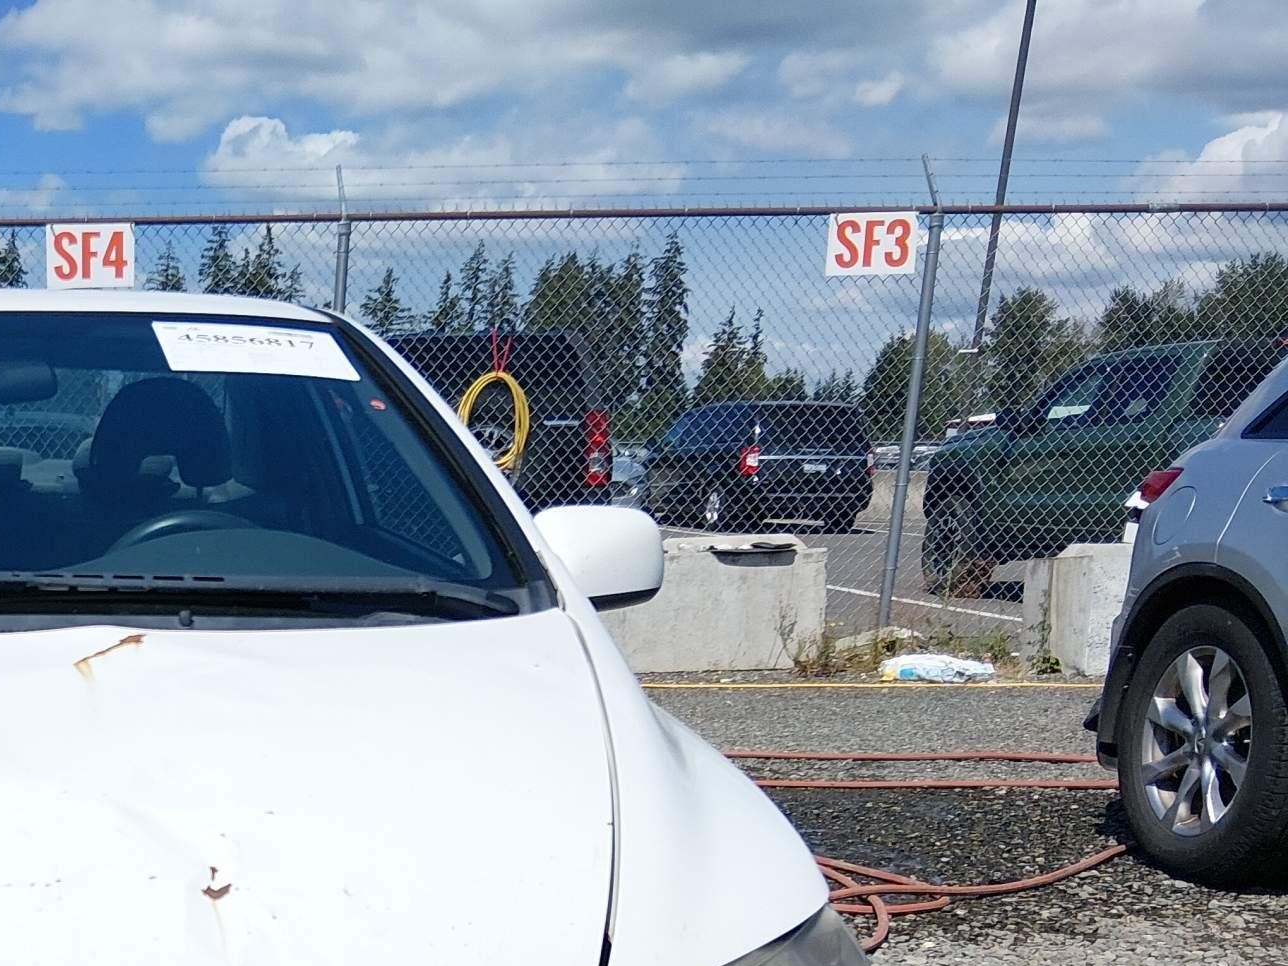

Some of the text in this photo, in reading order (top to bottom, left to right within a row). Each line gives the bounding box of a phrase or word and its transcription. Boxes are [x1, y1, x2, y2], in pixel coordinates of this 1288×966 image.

[53, 231, 128, 280] SF4
[834, 218, 911, 268] SF3
[177, 333, 314, 350] 45856817
